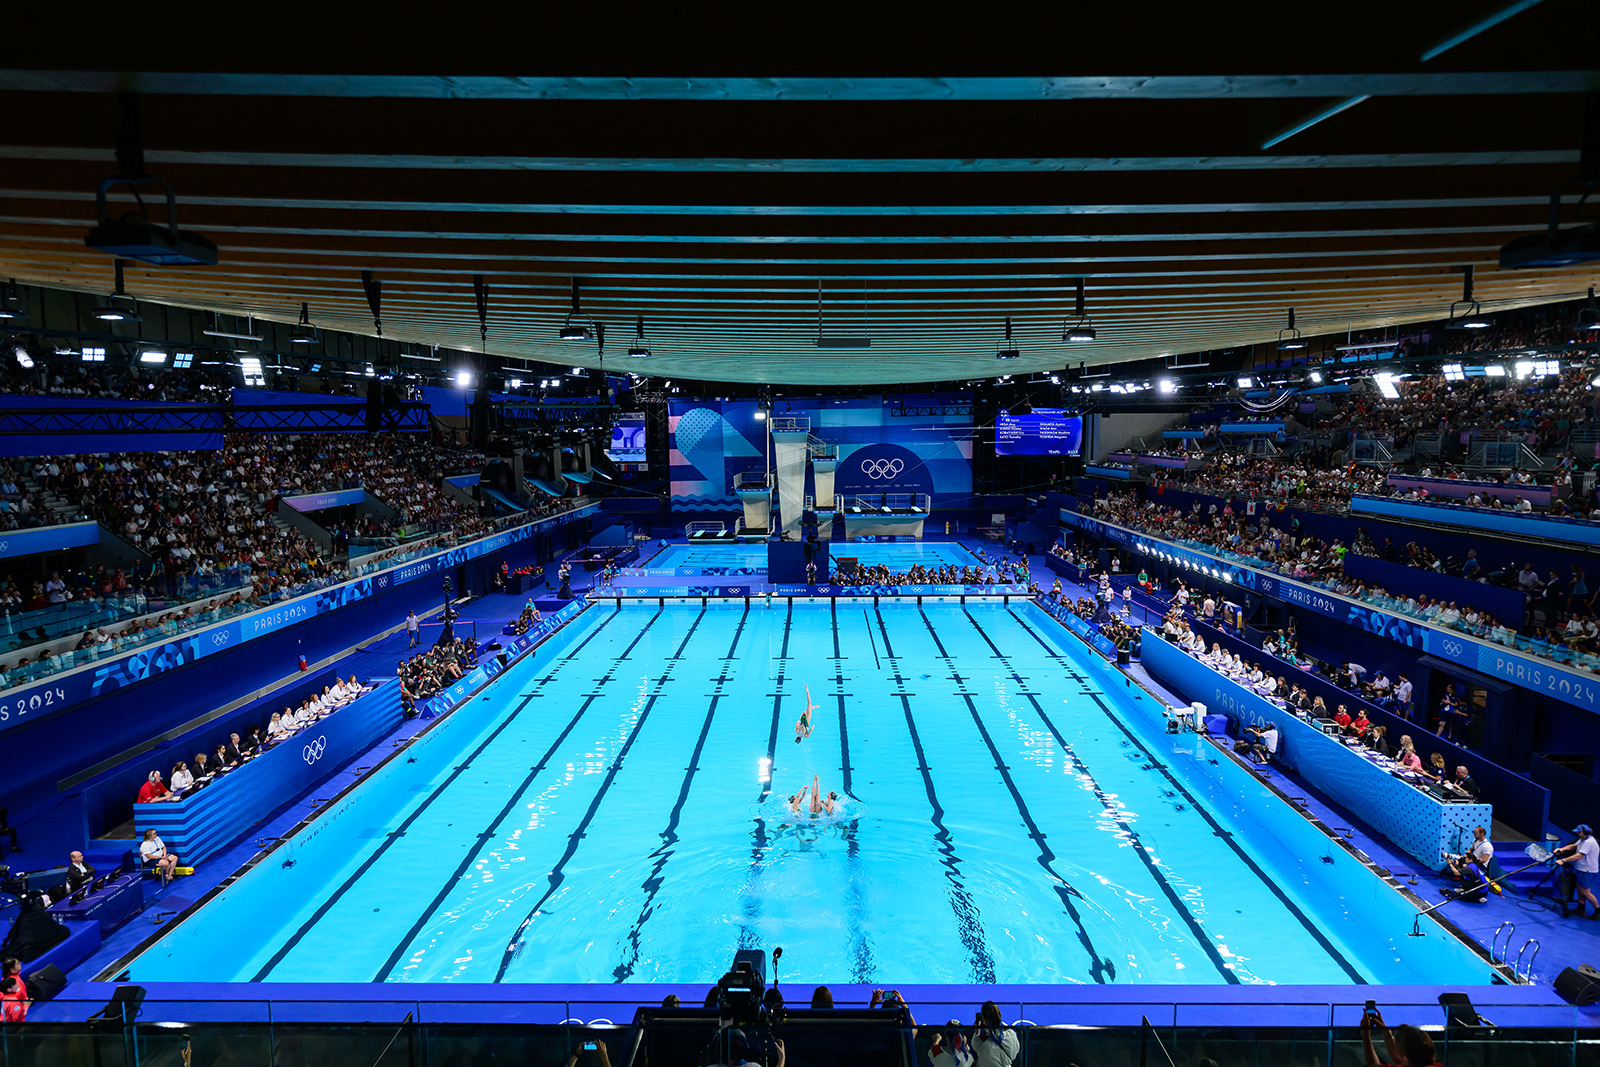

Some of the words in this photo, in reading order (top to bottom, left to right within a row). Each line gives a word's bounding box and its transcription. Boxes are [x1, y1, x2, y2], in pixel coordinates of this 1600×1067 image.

[284, 605, 307, 621] 2024
[1312, 596, 1335, 613] 2024
[1548, 675, 1594, 703] 2024
[17, 687, 65, 716] 2024
